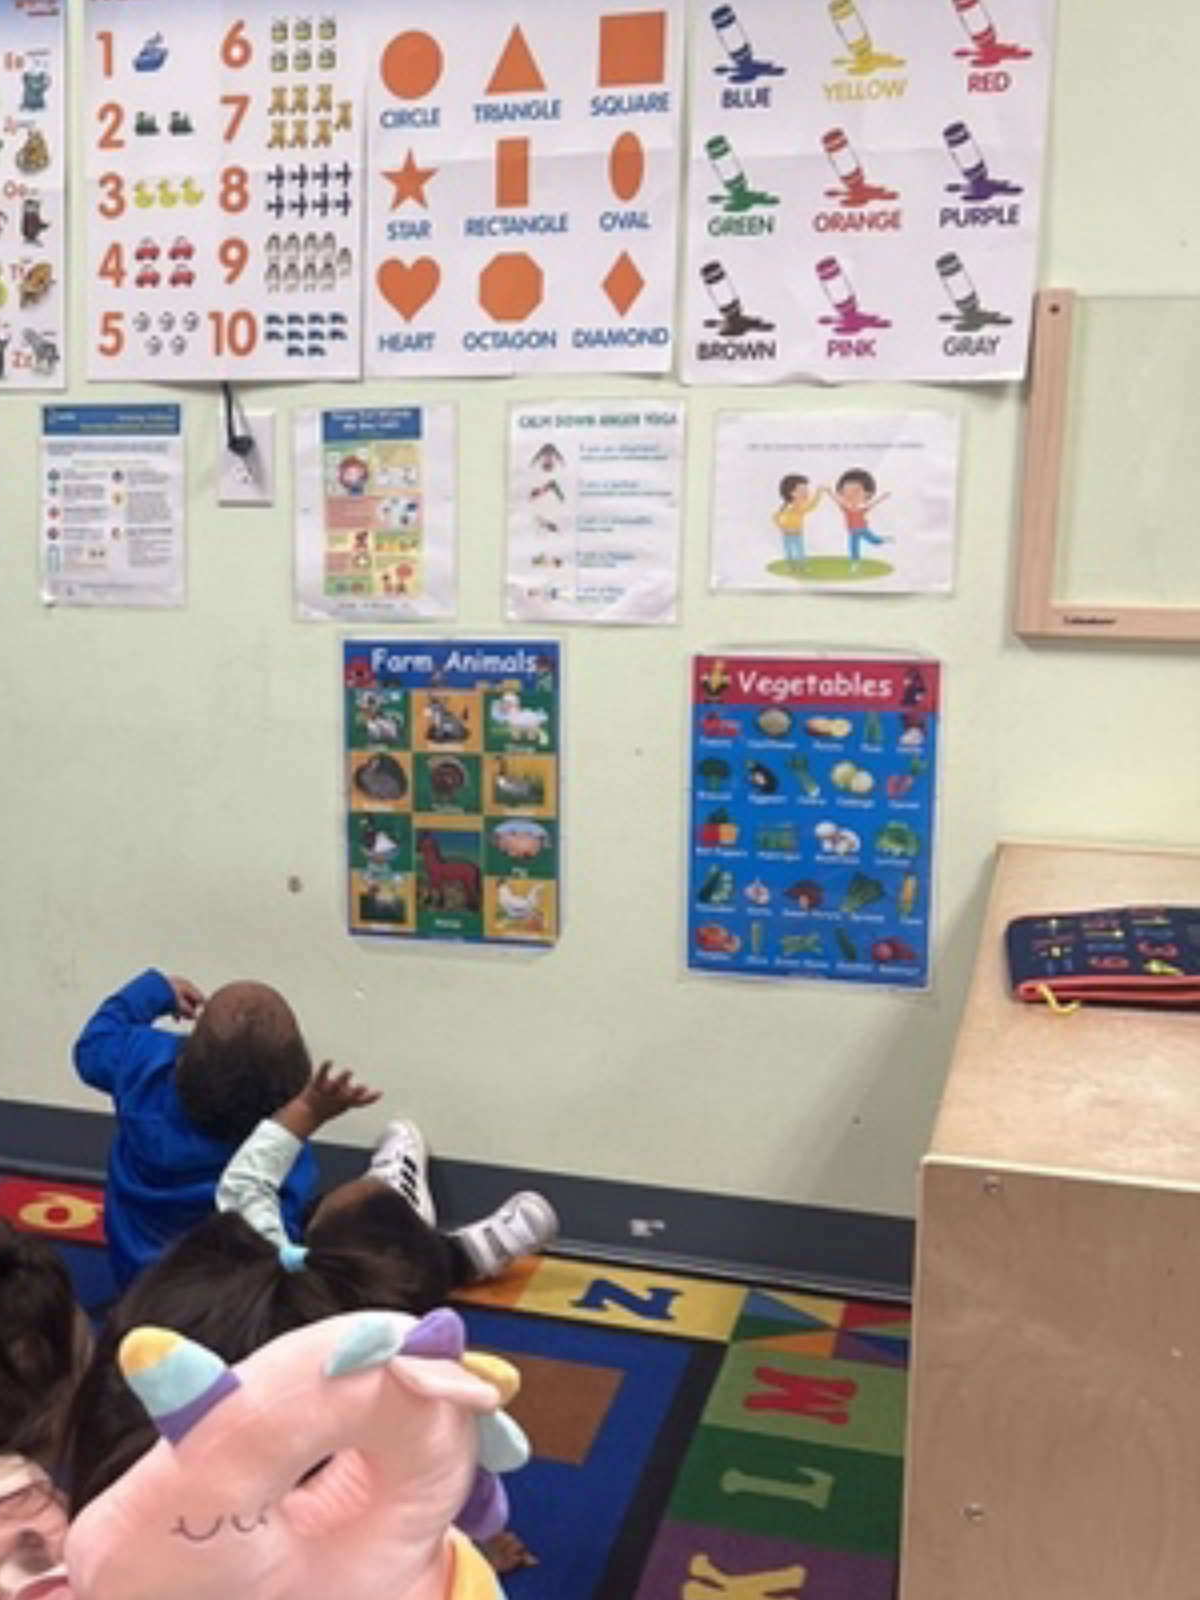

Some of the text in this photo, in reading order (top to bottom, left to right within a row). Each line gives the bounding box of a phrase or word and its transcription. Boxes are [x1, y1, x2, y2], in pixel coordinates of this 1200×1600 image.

[96, 31, 113, 78] 1
[220, 20, 252, 68] 6
[823, 80, 907, 99] YELLOW
[968, 72, 1010, 92] RED
[590, 93, 669, 117] SQUARE
[722, 88, 772, 108] BLUE
[219, 95, 250, 143] 7
[380, 108, 440, 128] CIRCLE
[473, 100, 561, 122] TRIANGLE
[97, 103, 125, 149] 2
[98, 173, 126, 218] 3
[219, 166, 248, 213] 8
[465, 214, 567, 235] RECTANGLE
[600, 212, 650, 232] OVAL
[708, 216, 773, 236] GREEN
[814, 210, 901, 232] ORANGE
[940, 205, 1018, 228] PURPLE
[387, 221, 430, 239] STAR
[98, 242, 127, 287] 4
[218, 238, 248, 284] 9
[97, 311, 124, 356] 5
[208, 310, 256, 356] 10
[379, 332, 434, 351] HEART
[463, 331, 556, 350] OCTAGON
[573, 328, 668, 347] DIAMOND
[697, 341, 775, 360] BROWN
[827, 339, 876, 358] PINK
[944, 336, 1000, 356] GRAY
[371, 648, 537, 674] Farm Animals
[737, 671, 893, 702] Vegetables
[743, 1367, 857, 1424] M
[721, 1466, 835, 1510] L
